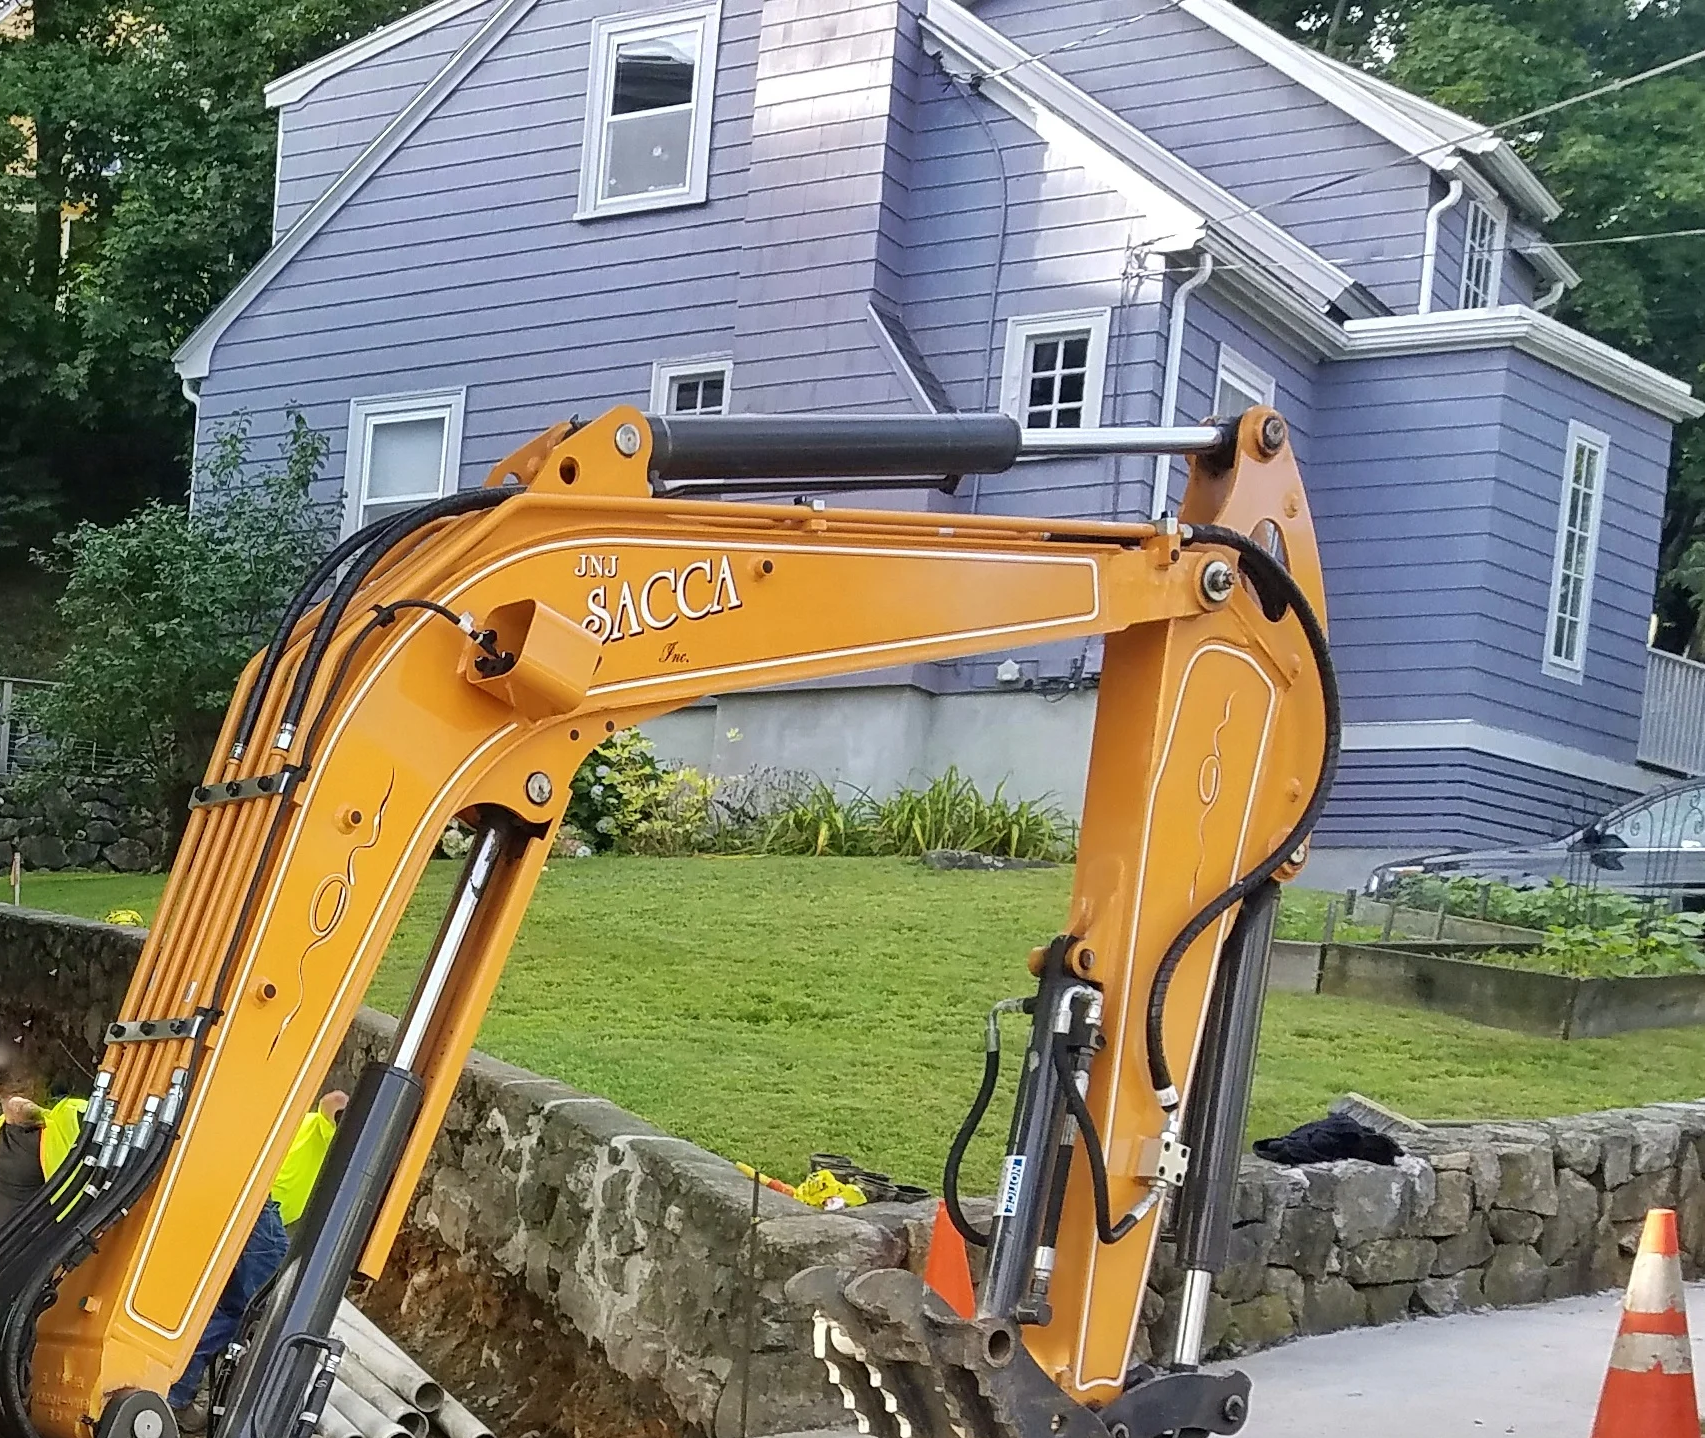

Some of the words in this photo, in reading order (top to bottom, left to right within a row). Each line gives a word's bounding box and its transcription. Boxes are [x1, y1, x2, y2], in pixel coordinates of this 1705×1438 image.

[574, 554, 618, 578] JNJ
[581, 554, 743, 646] SACCA
[658, 641, 690, 664] Inc.
[1004, 1166, 1022, 1214] NOTICE
